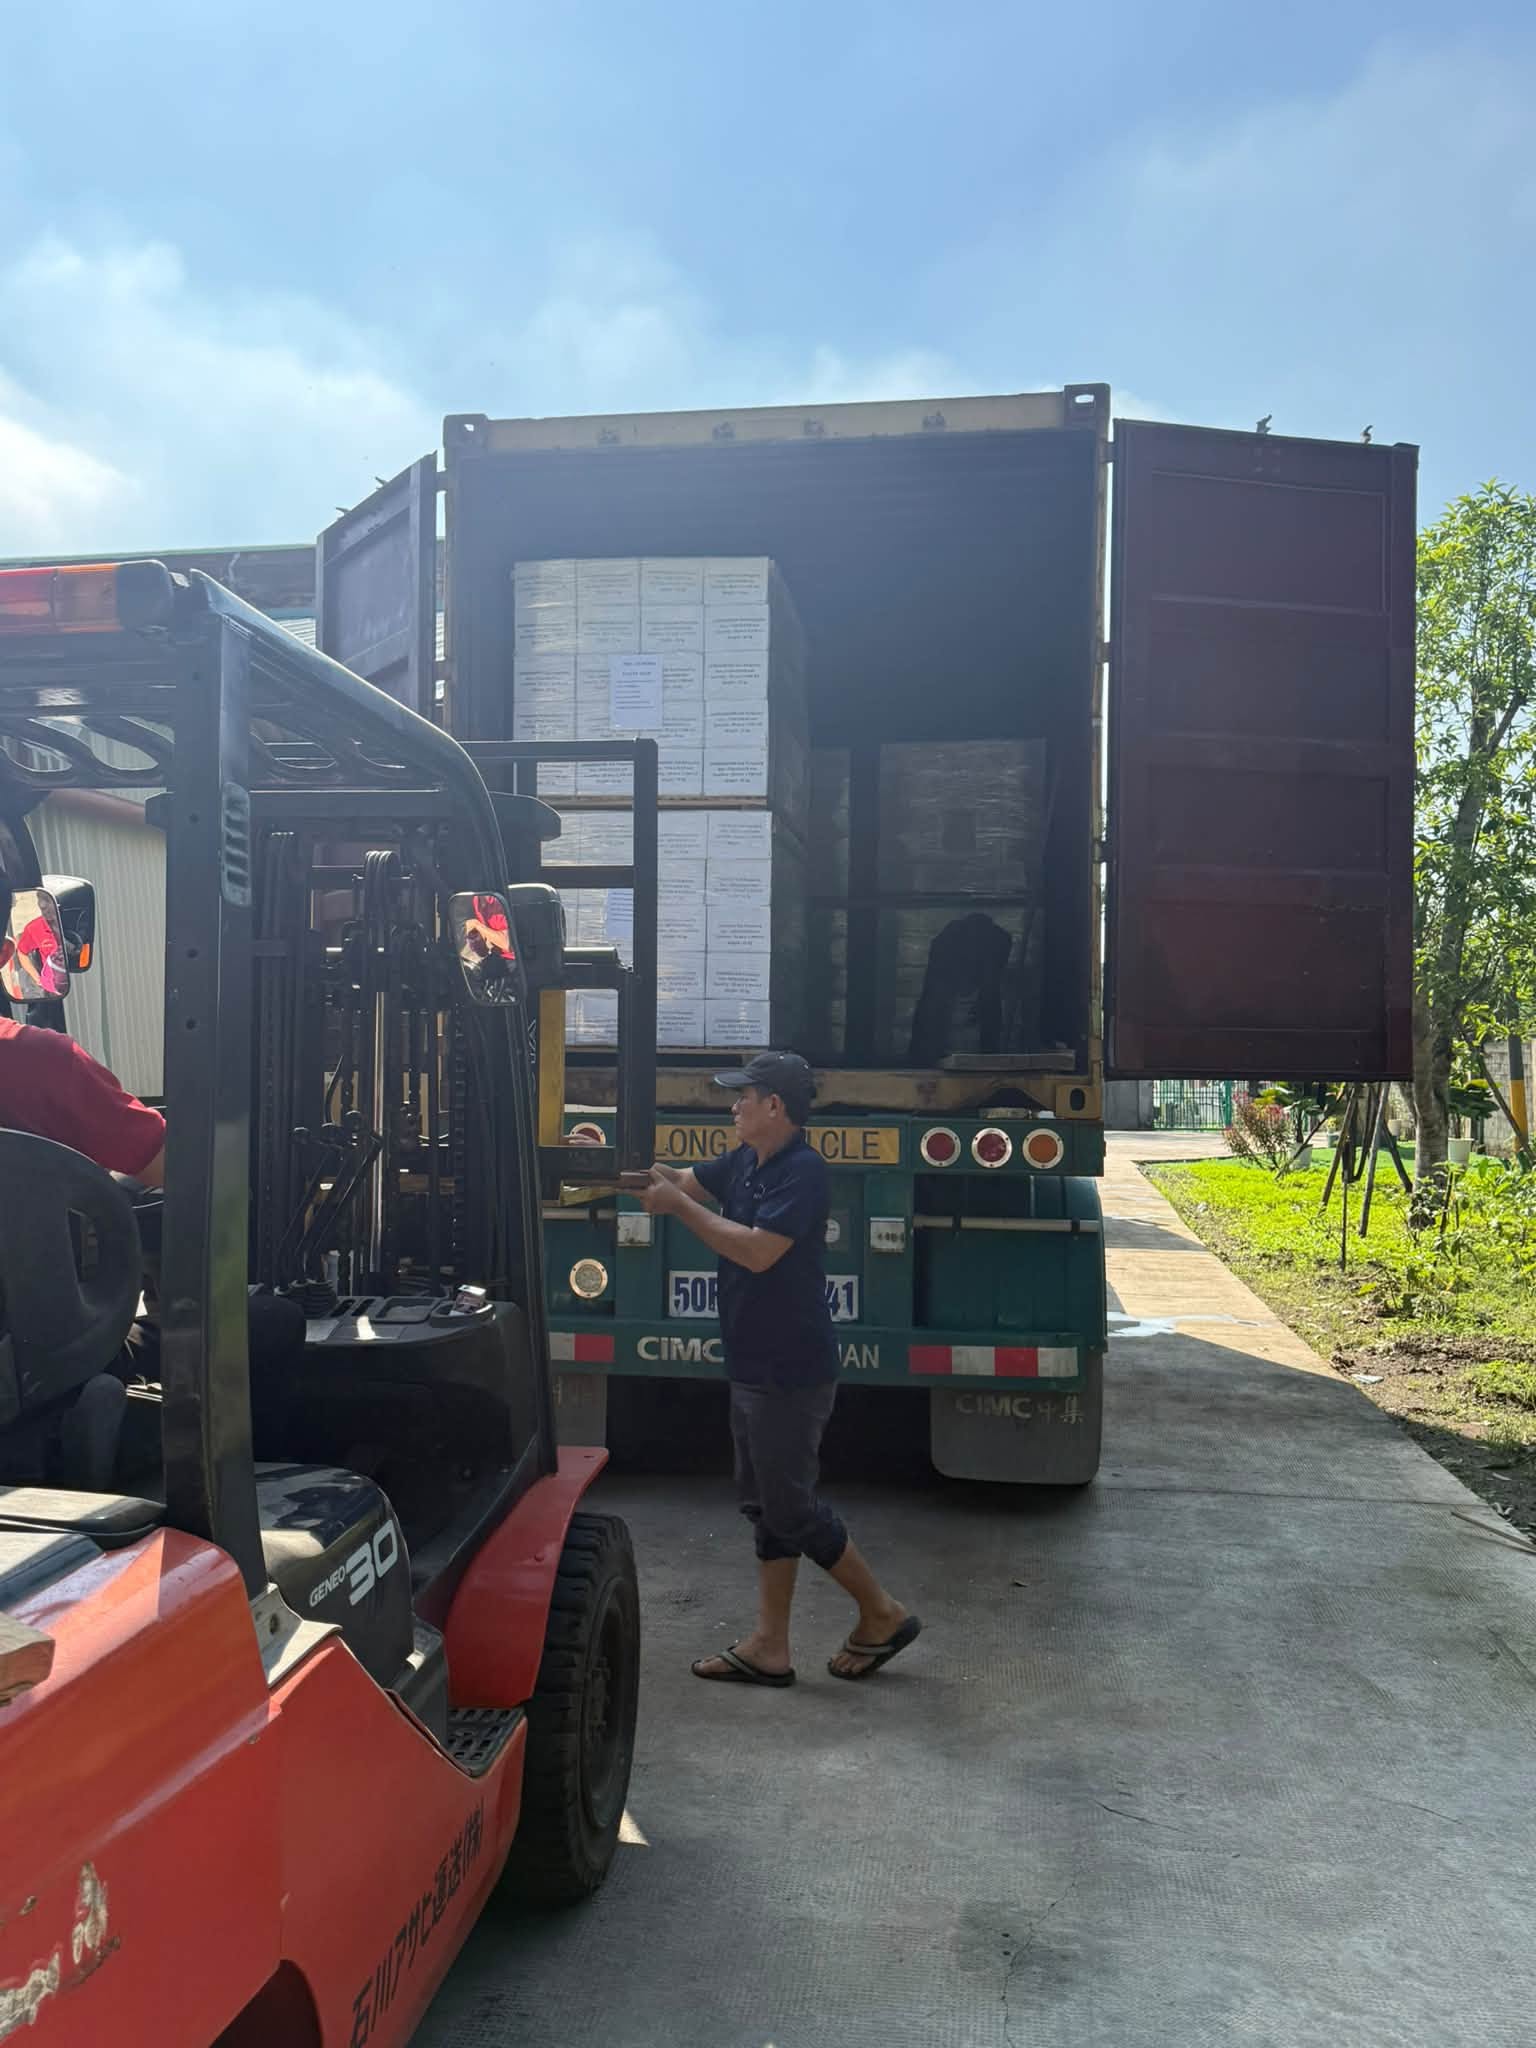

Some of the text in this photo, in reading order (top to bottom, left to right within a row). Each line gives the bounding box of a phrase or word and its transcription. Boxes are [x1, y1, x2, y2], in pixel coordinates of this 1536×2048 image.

[636, 1336, 880, 1369] CIMC AN
[955, 1393, 1033, 1420] CIMC
[309, 1519, 398, 1608] GENEO 30
